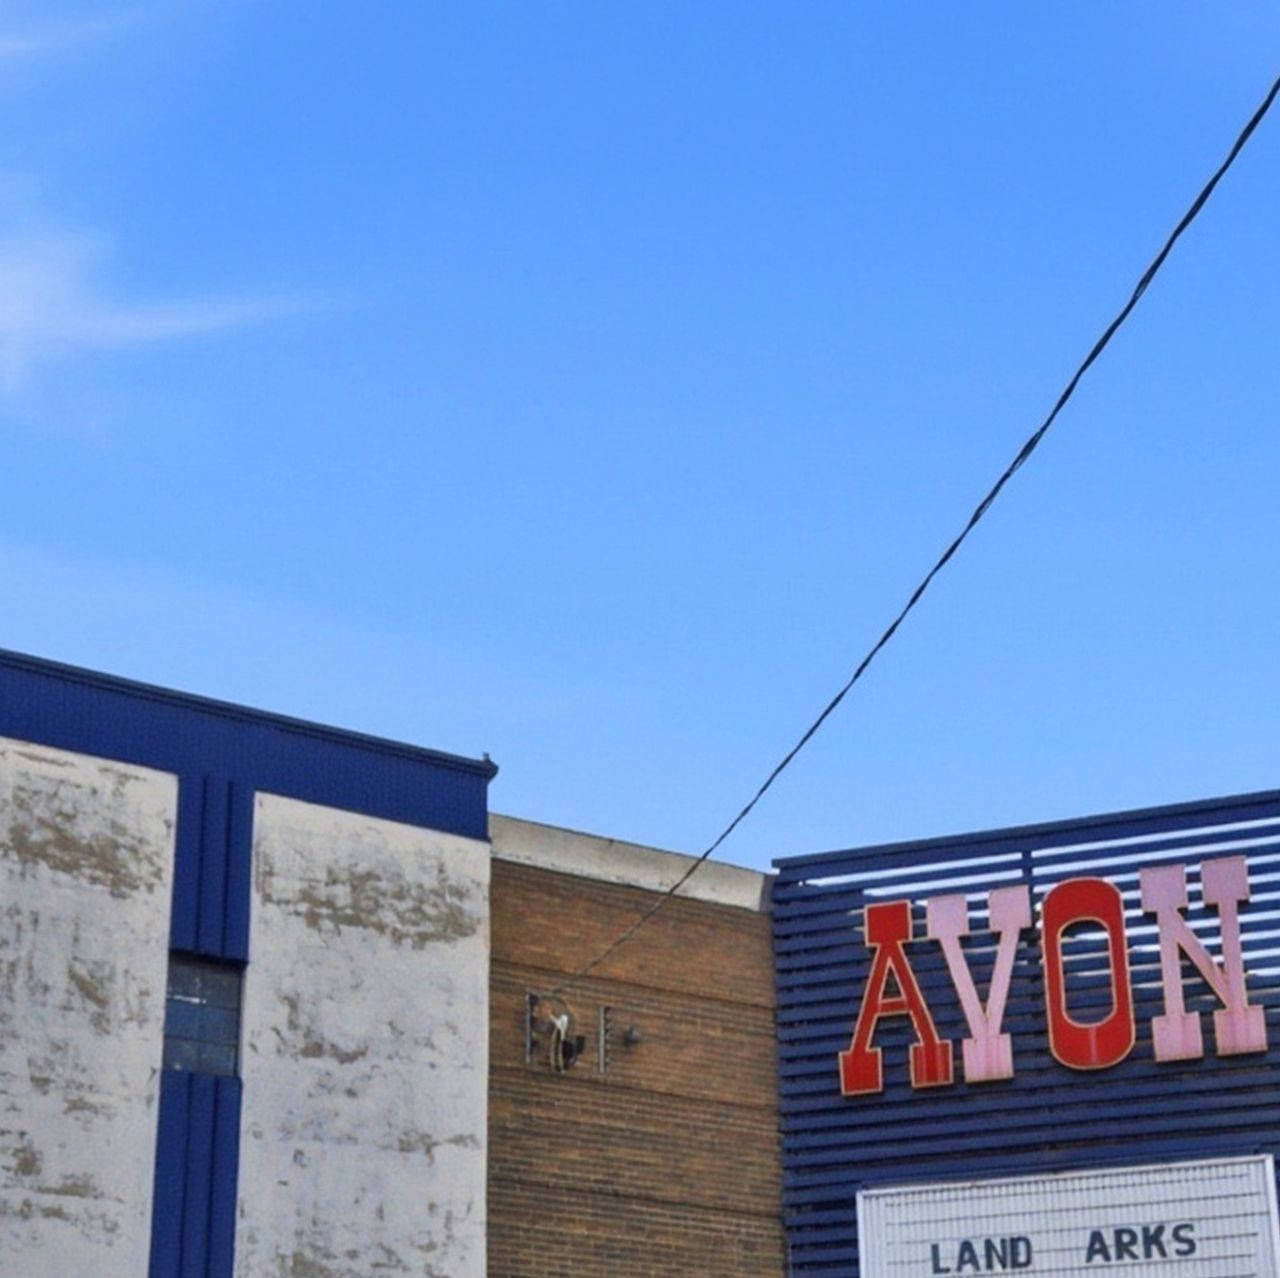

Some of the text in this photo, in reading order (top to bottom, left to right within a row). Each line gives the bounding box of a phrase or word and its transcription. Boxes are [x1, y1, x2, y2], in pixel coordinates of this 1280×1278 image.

[838, 854, 1268, 1096] AVON
[931, 1223, 1197, 1275] LAND ARKS
